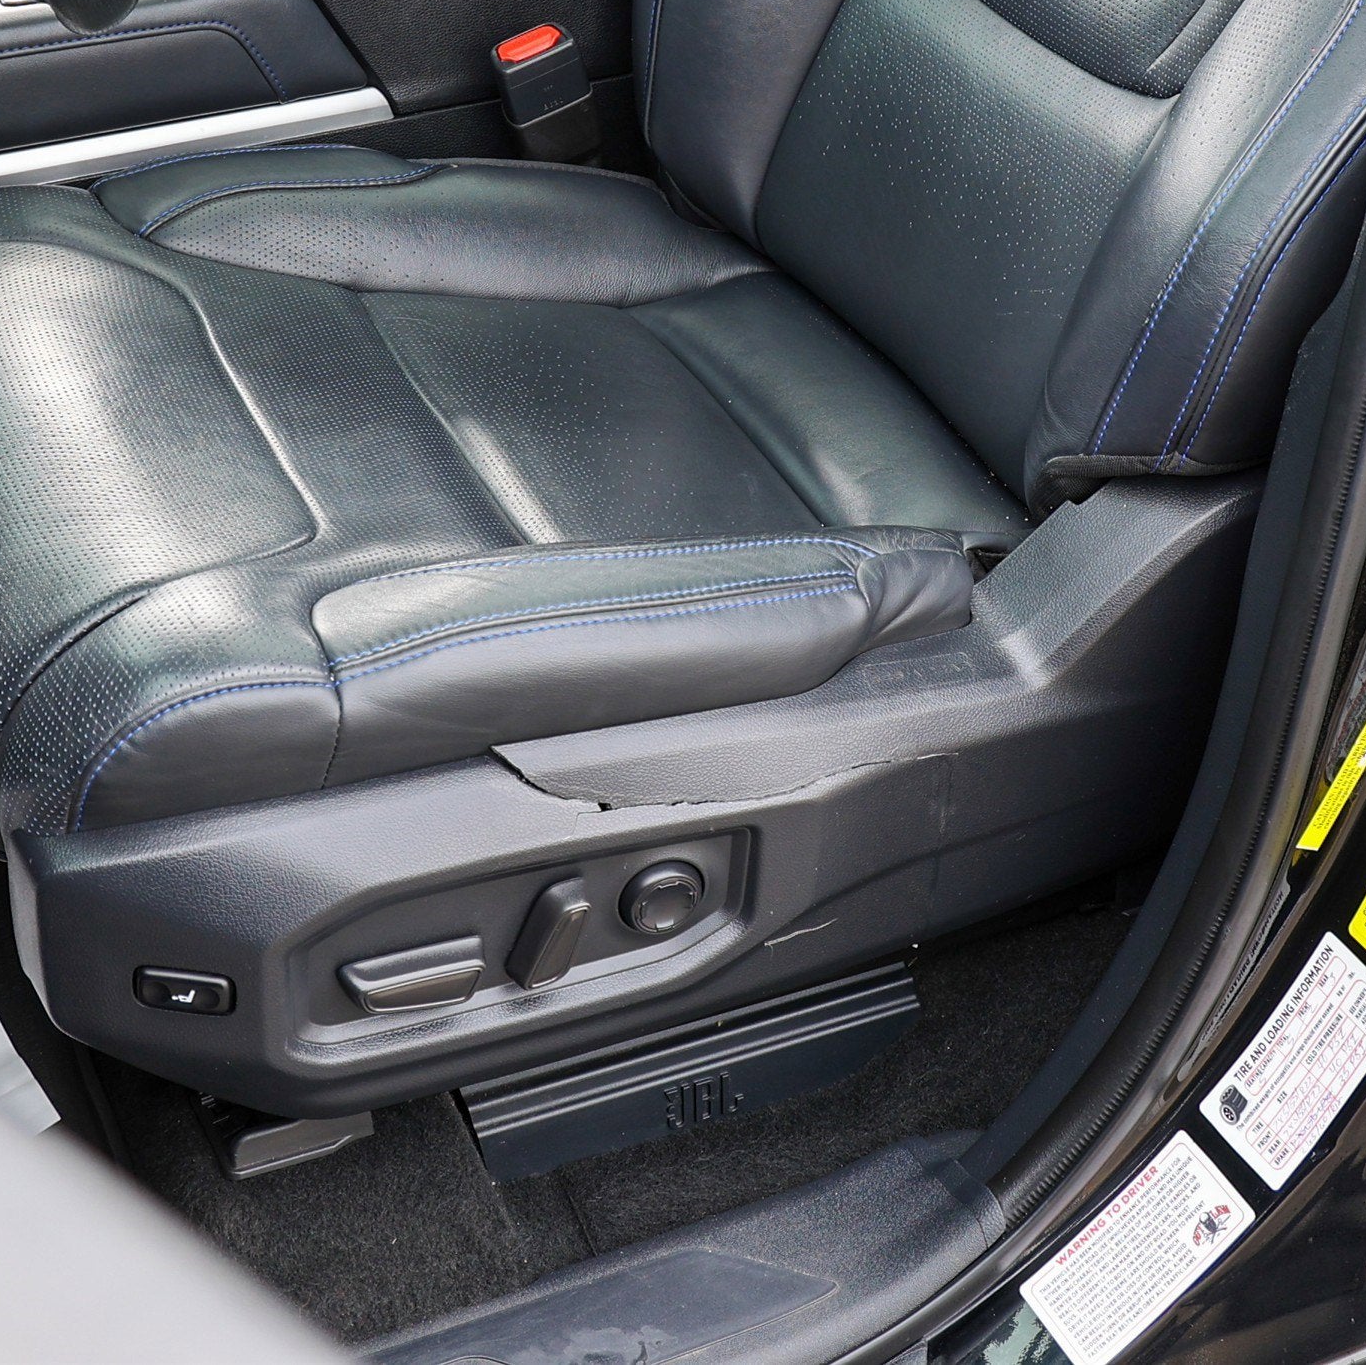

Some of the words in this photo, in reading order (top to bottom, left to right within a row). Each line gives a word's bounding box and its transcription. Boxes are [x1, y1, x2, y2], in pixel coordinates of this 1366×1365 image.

[1234, 1061, 1252, 1081] TIRE
[1250, 1042, 1266, 1063] AND
[1264, 1004, 1294, 1044] LOADING
[1291, 945, 1333, 1005] INFORMATION
[663, 1072, 744, 1130] JBL
[1252, 1122, 1263, 1132] TIRE
[1277, 1091, 1287, 1103] SIZE
[1305, 1050, 1317, 1065] COLD
[1315, 1038, 1325, 1049] TIRE
[1323, 1014, 1342, 1039] PRESSURE
[1258, 1131, 1270, 1148] FRONT
[1268, 1140, 1280, 1154] REAR
[1056, 1219, 1105, 1264] WARNING
[1105, 1203, 1120, 1218] TO
[1121, 1166, 1158, 1204] DRIVER
[1211, 1205, 1230, 1219] LAW
